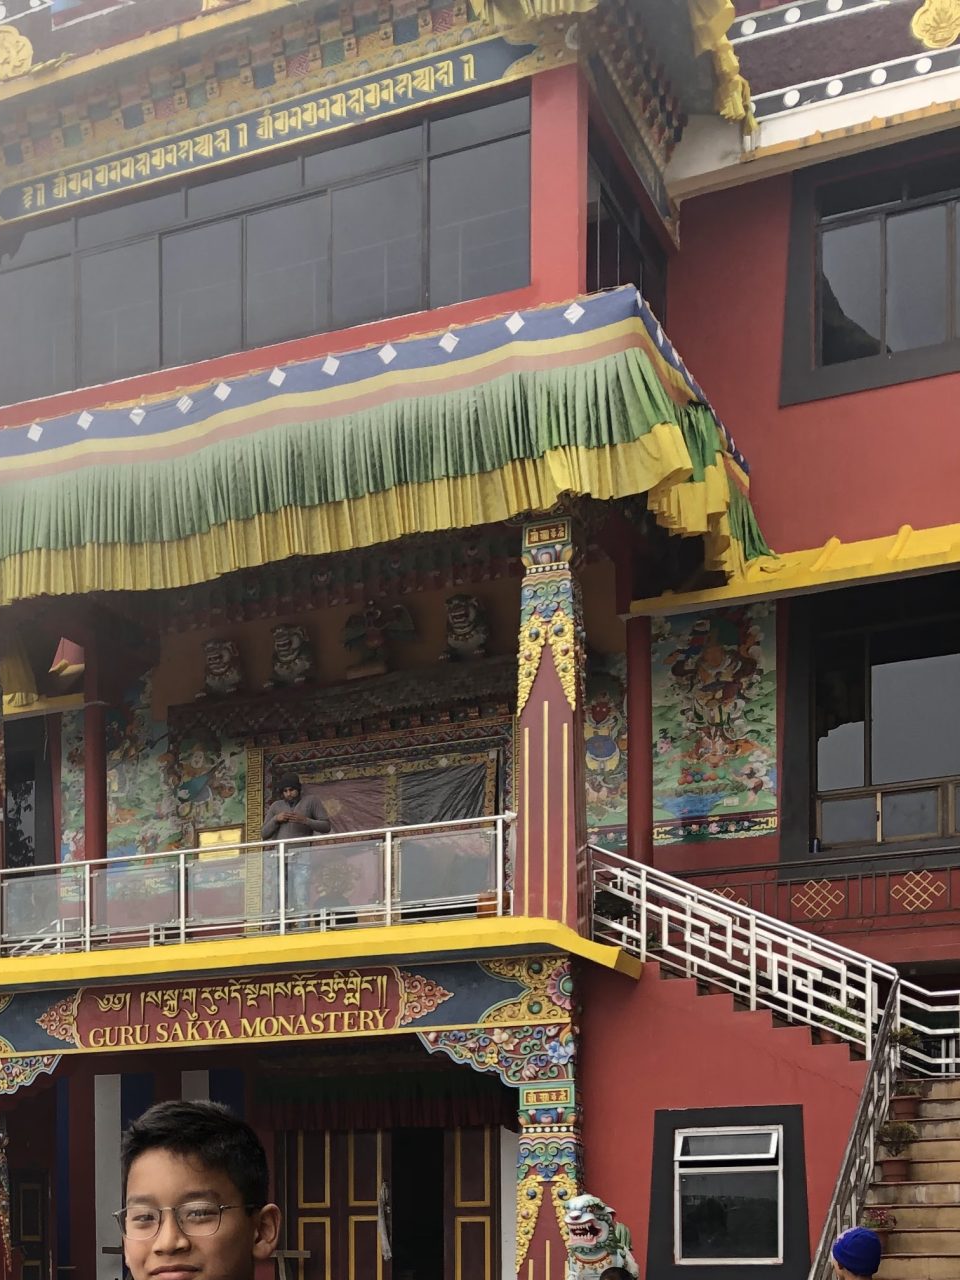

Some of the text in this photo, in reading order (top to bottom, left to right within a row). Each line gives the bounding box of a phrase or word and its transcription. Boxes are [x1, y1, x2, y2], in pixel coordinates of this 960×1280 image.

[89, 1008, 390, 1048] GURU SAKYA MONASTERY
